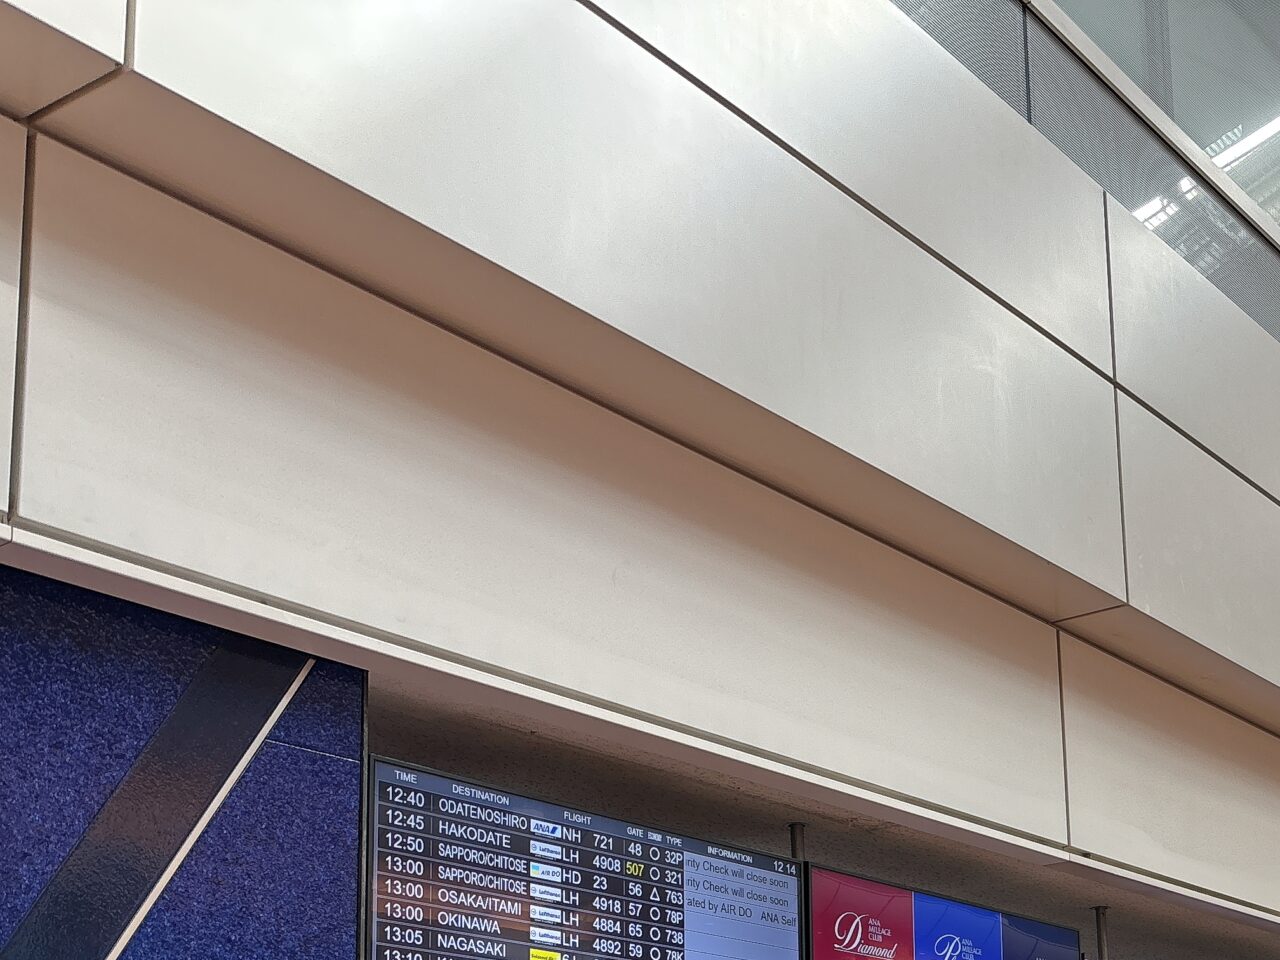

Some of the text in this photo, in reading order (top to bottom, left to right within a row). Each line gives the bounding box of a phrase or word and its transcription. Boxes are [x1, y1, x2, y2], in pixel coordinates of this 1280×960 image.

[386, 786, 642, 856] 12:40 ODATENOSHIRO NH 721 48
[386, 810, 644, 877] 12:45 HAKODATE LH 4908 507
[394, 770, 417, 784] TIME
[452, 784, 510, 806] DESTINATION
[564, 811, 592, 825] FLIGHT
[626, 826, 644, 838] GATE
[666, 836, 682, 846] TYPE
[708, 846, 752, 864] INFORMATION
[386, 832, 642, 896] 12:50 SAPPORO/CHITOSE HD 23 56
[386, 856, 642, 917] 13:00 SAPPORO/CHITOSE LH 4918 57
[703, 860, 788, 888] Check close soon
[385, 879, 642, 937] 13:00 OSAKA/ITAMI LH 4884 65
[703, 880, 788, 907] Check close soon
[708, 899, 718, 912] by
[721, 903, 736, 915] AIR
[739, 907, 752, 918] DO
[761, 911, 779, 924] ANA
[384, 902, 642, 957] 13:00 OKINAWA LH 4892 59
[384, 926, 422, 945] 13:05
[438, 934, 506, 957] NAGASAKI
[834, 912, 898, 959] Diamond
